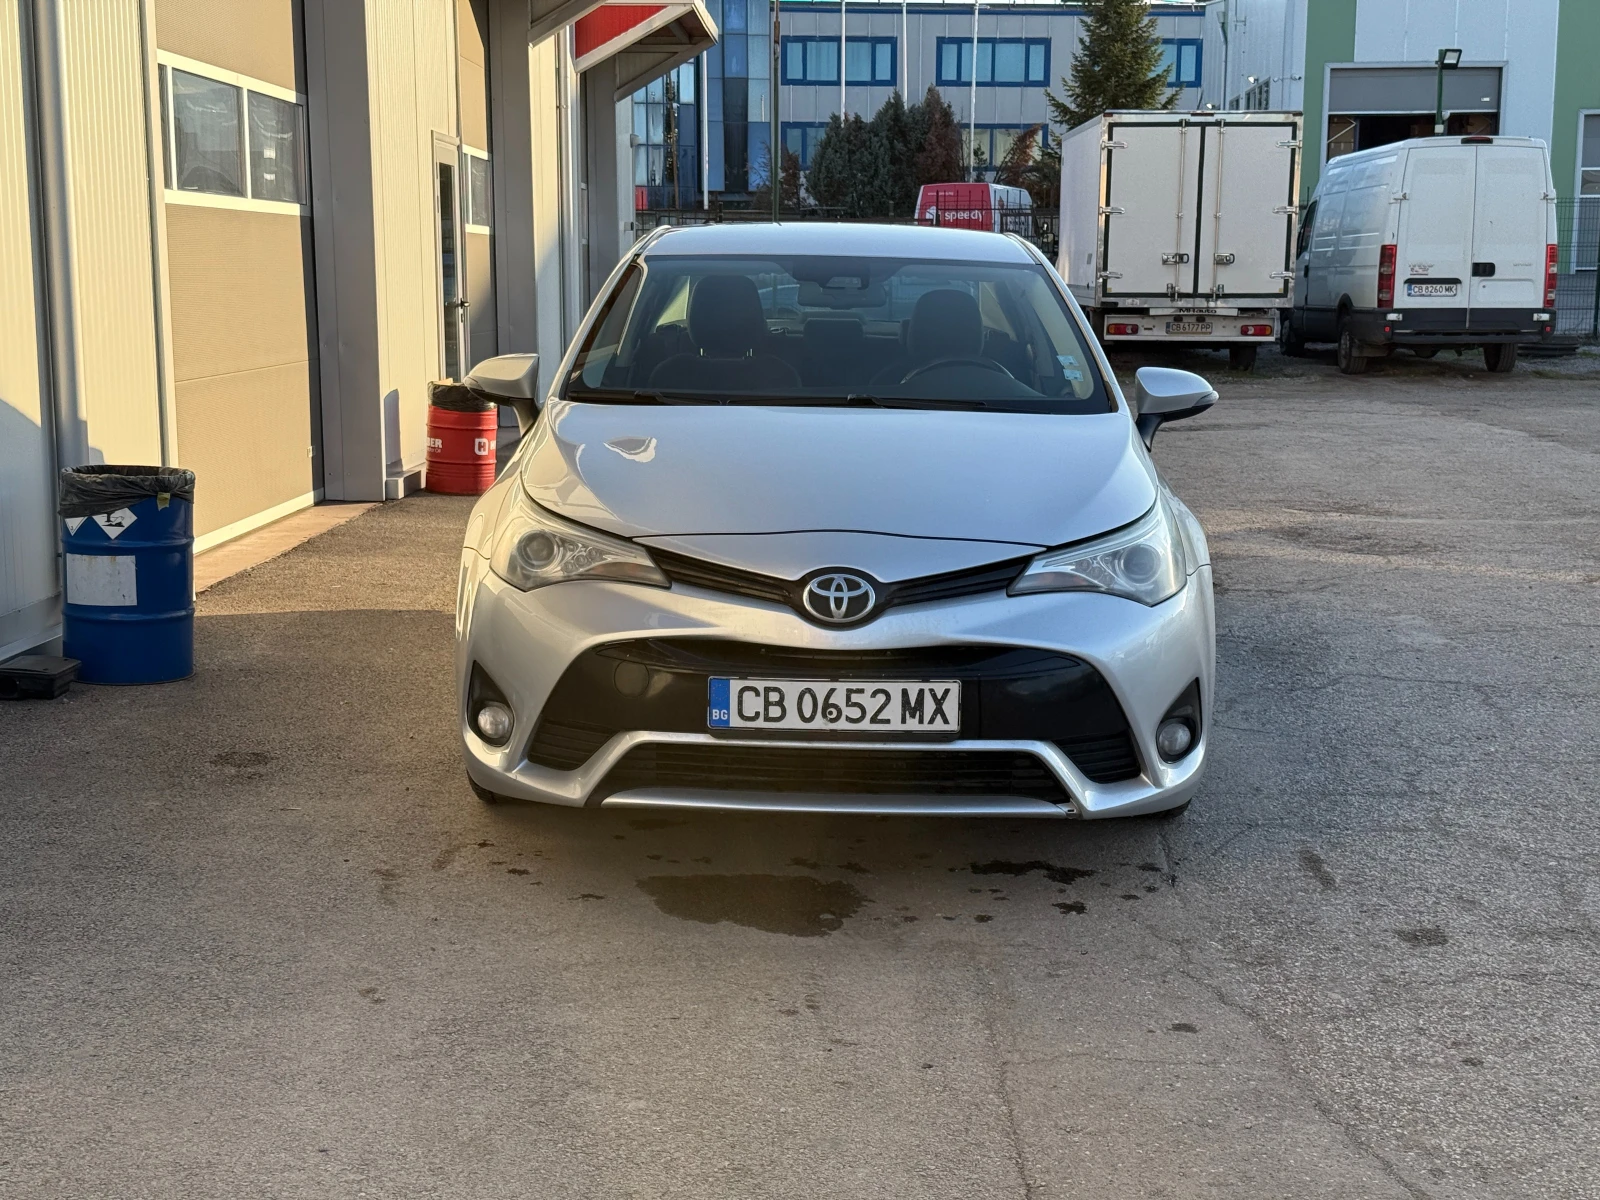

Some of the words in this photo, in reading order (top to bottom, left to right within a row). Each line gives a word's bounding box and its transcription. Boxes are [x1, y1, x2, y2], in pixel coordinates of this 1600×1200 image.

[944, 209, 985, 222] speedy
[1413, 285, 1423, 294] CB
[1424, 285, 1444, 294] 8260
[1444, 285, 1455, 294] MK
[1171, 323, 1181, 332] CB
[1182, 323, 1200, 332] 6177
[1201, 323, 1211, 332] PP
[712, 709, 728, 721] BG
[737, 685, 787, 723] CB
[796, 687, 892, 725] 0652
[900, 687, 952, 725] MX
